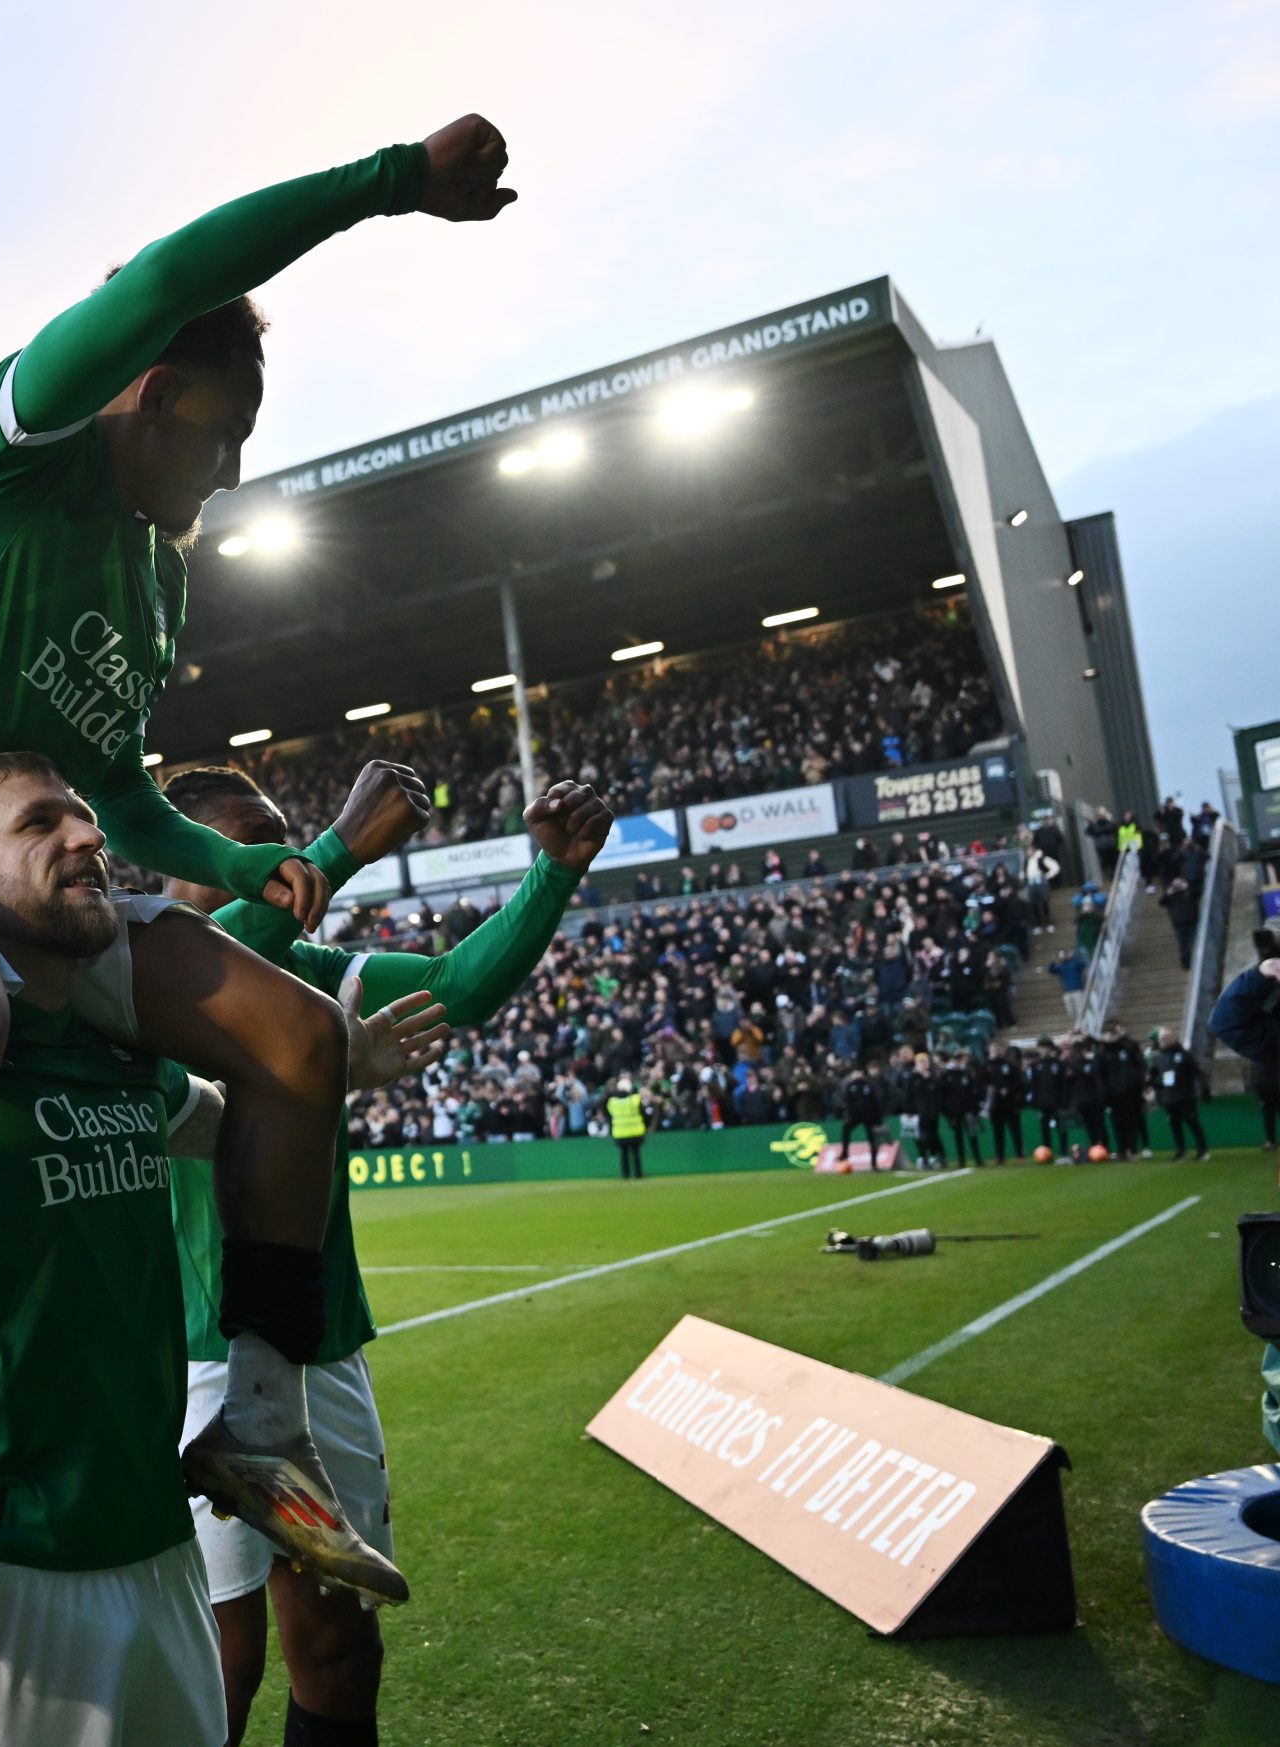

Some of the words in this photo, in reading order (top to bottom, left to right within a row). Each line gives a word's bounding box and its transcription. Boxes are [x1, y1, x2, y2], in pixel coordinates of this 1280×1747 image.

[277, 470, 317, 498] THE
[321, 443, 404, 486] BEACON
[408, 403, 536, 459] ELECTRICAL
[541, 356, 685, 418] MAYFLOWER
[691, 297, 869, 370] GRANDSTAND
[34, 1090, 158, 1141] Classic
[626, 1351, 784, 1468] Emirates
[758, 1416, 858, 1499] FLY
[804, 1438, 977, 1567] BETTER
